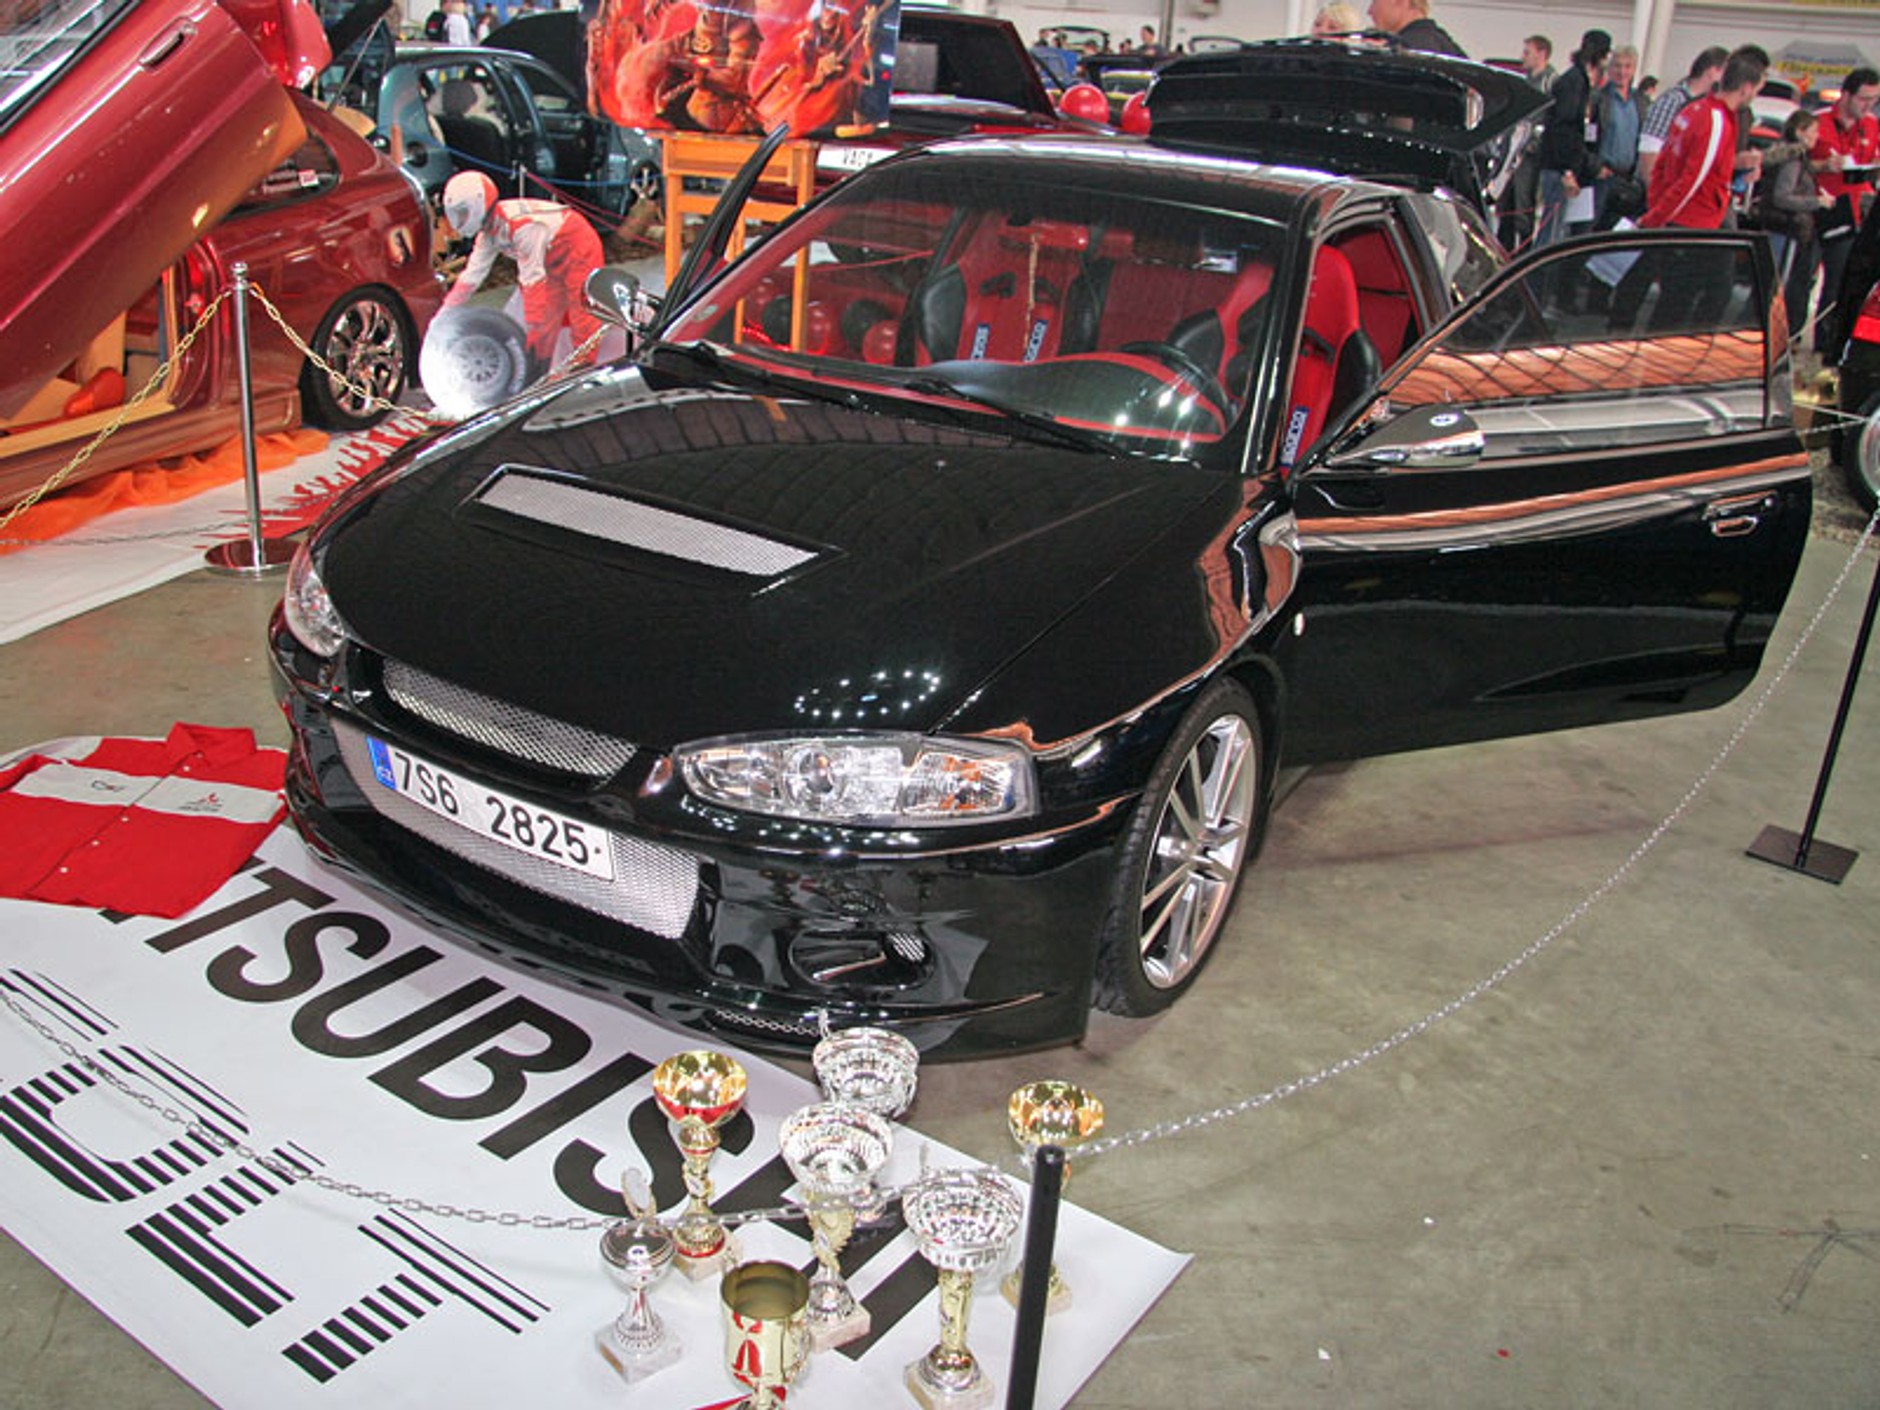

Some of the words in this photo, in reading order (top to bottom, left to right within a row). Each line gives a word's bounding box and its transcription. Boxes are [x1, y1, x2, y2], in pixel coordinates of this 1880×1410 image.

[394, 752, 459, 815] 7S6
[486, 795, 589, 865] 2825
[0, 970, 551, 1383] OLT
[97, 855, 940, 1361] TSUBISHI
